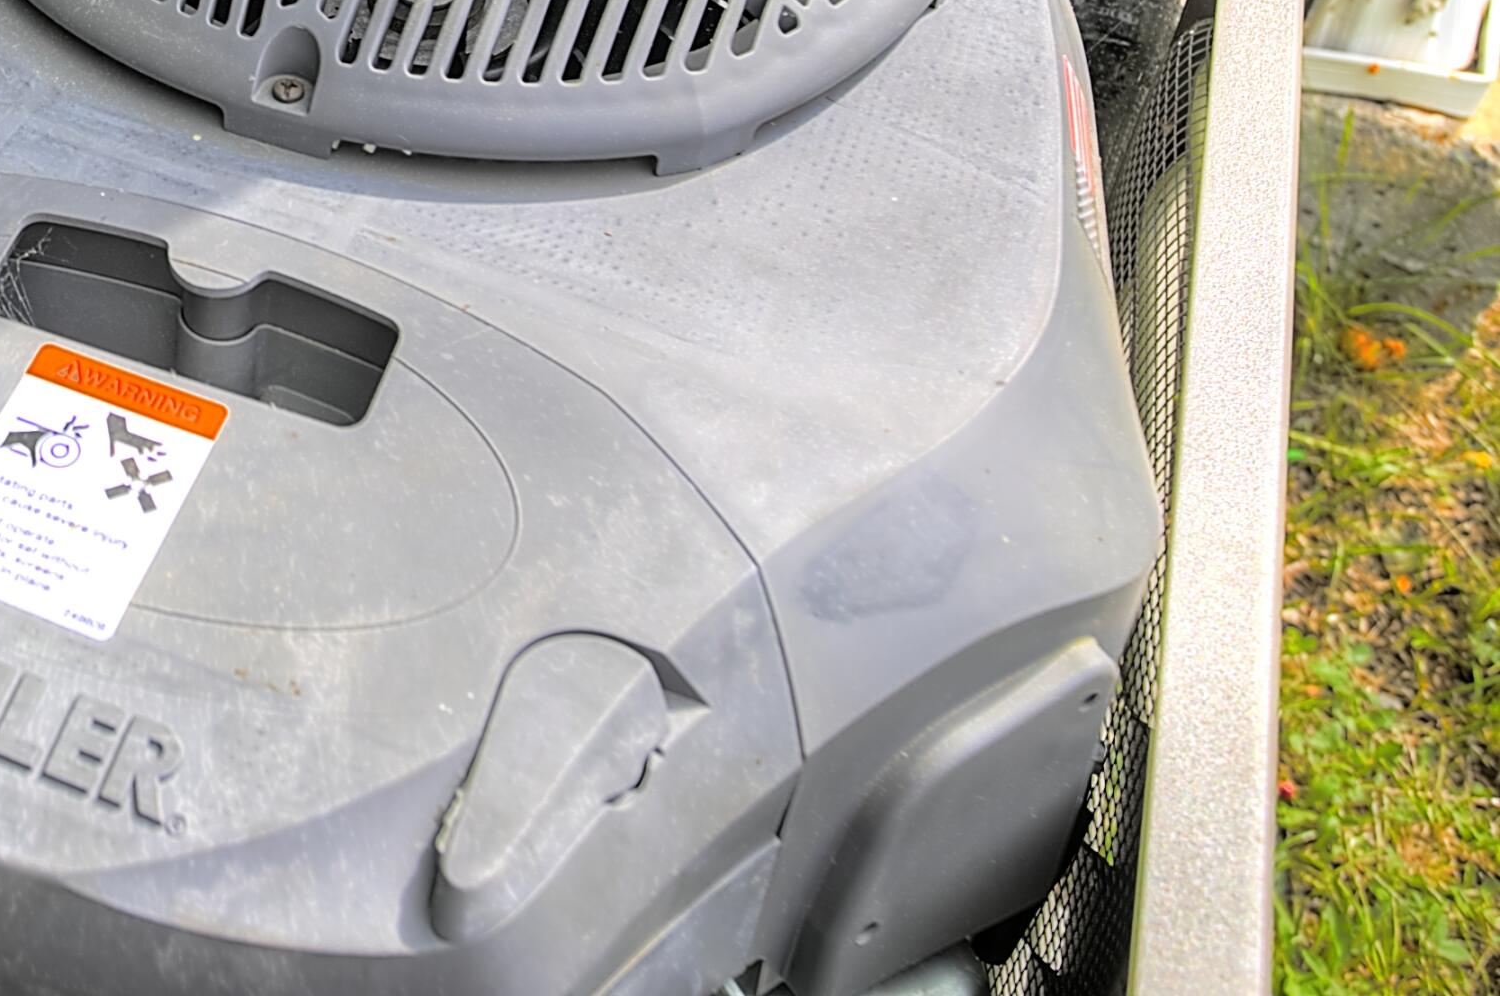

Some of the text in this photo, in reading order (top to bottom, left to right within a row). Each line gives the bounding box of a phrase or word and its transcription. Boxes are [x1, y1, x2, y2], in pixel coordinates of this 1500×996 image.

[83, 365, 202, 424] WARNING
[3, 496, 41, 513] cause
[46, 512, 88, 532] severe
[6, 522, 54, 545] operate
